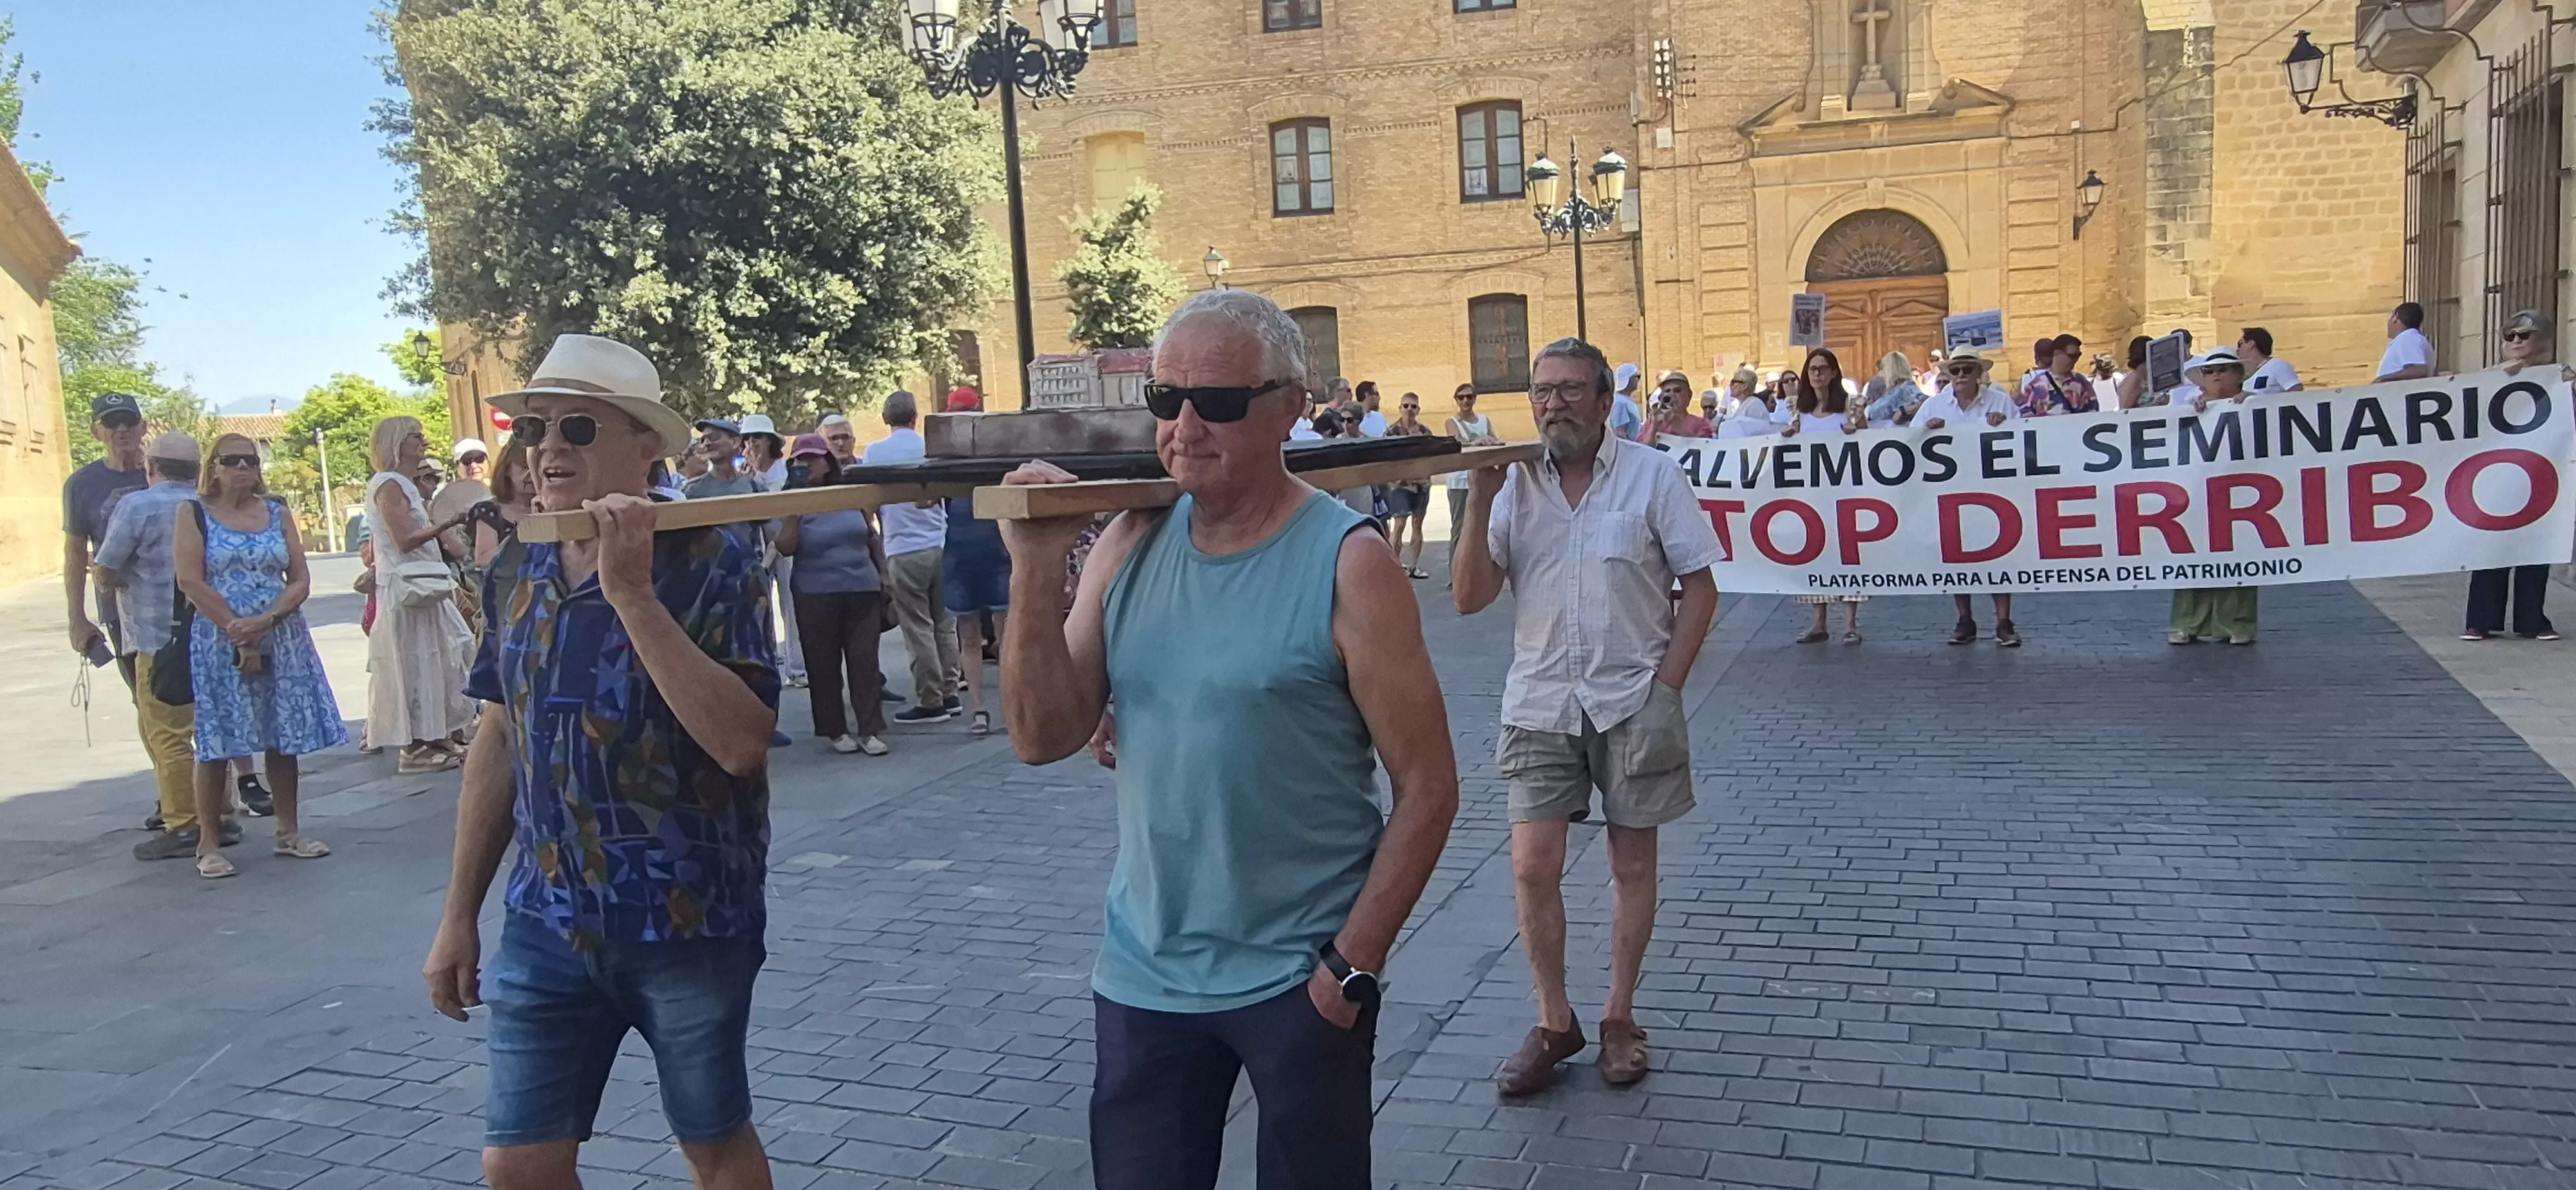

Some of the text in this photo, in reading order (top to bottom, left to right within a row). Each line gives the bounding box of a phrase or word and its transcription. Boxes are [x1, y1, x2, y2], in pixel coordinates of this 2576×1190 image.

[1656, 381, 2552, 489] ALVEMOS EL SEMINARIO
[1697, 448, 2559, 566] TOP DERRIBO
[1808, 558, 2302, 588] PLATAFORMA PARA LA DEFENSA DEL PATRIMONIO
